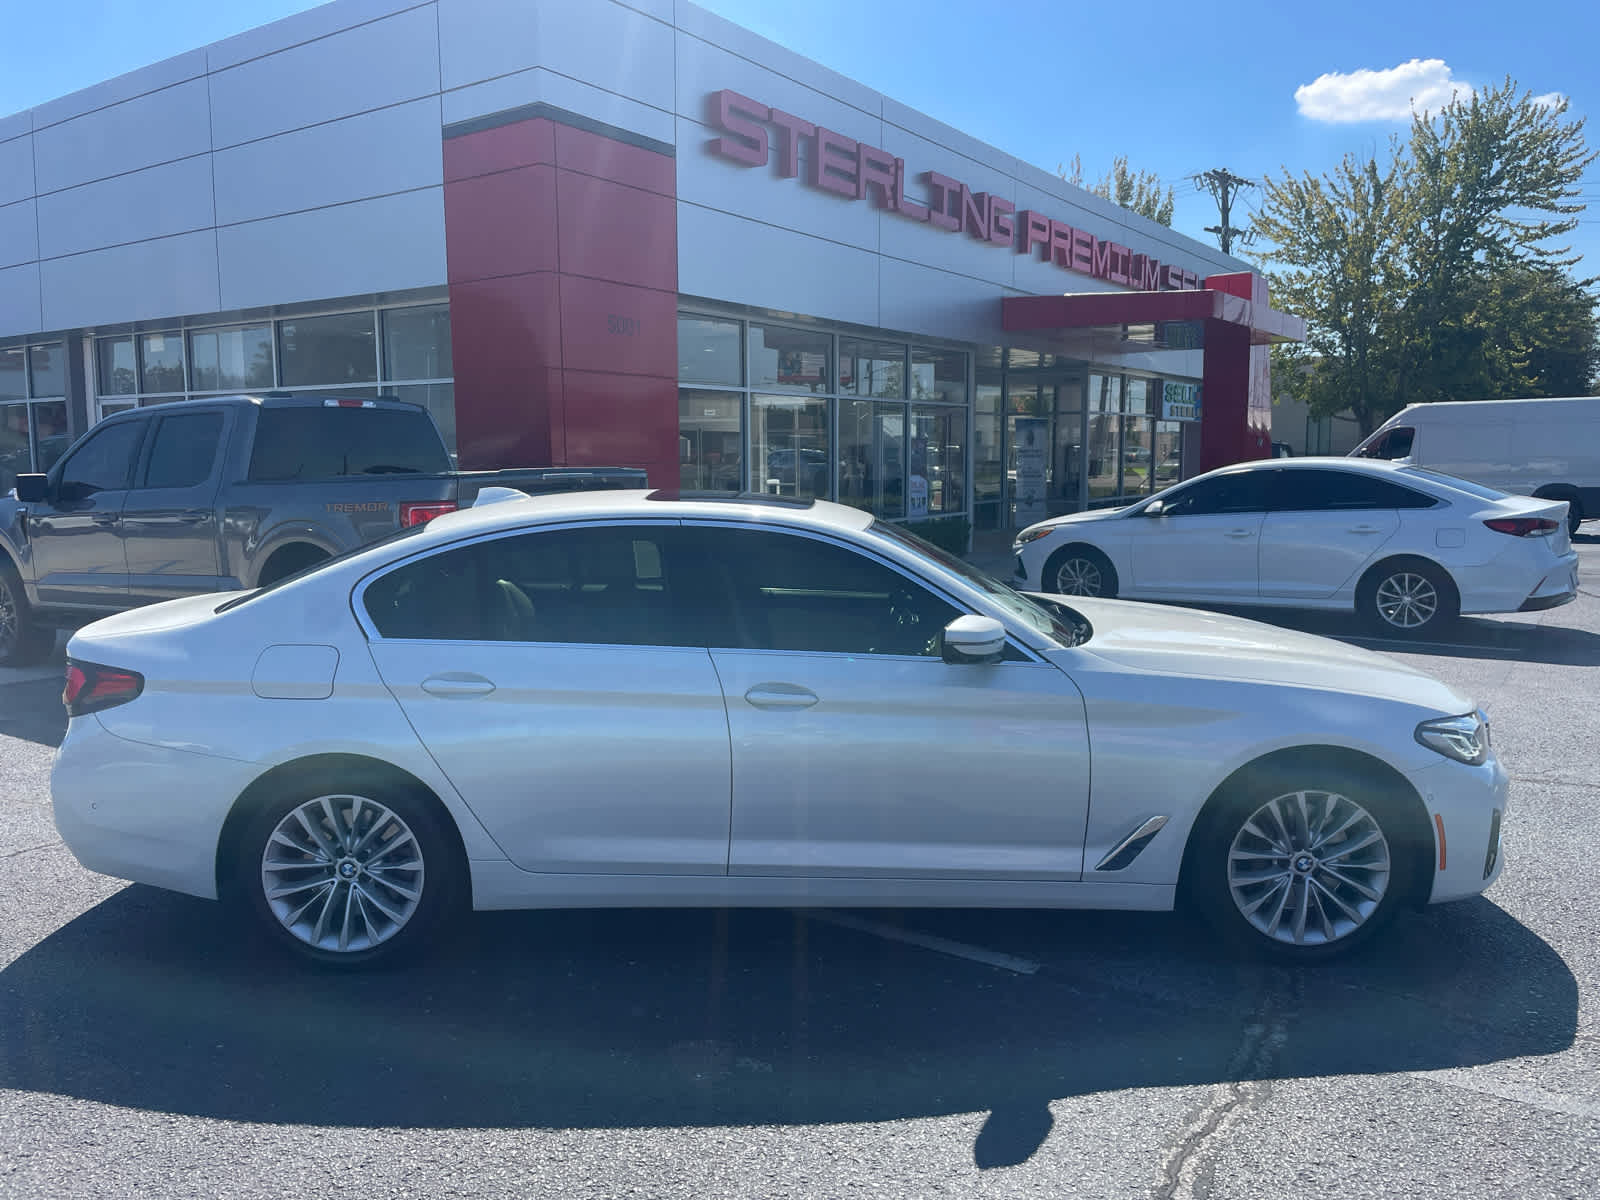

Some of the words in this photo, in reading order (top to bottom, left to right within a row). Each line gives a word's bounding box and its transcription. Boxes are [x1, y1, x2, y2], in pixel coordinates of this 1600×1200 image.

[705, 88, 1015, 247] STERLING
[1017, 209, 1160, 291] PREMIUM
[325, 502, 388, 513] TREMOR
